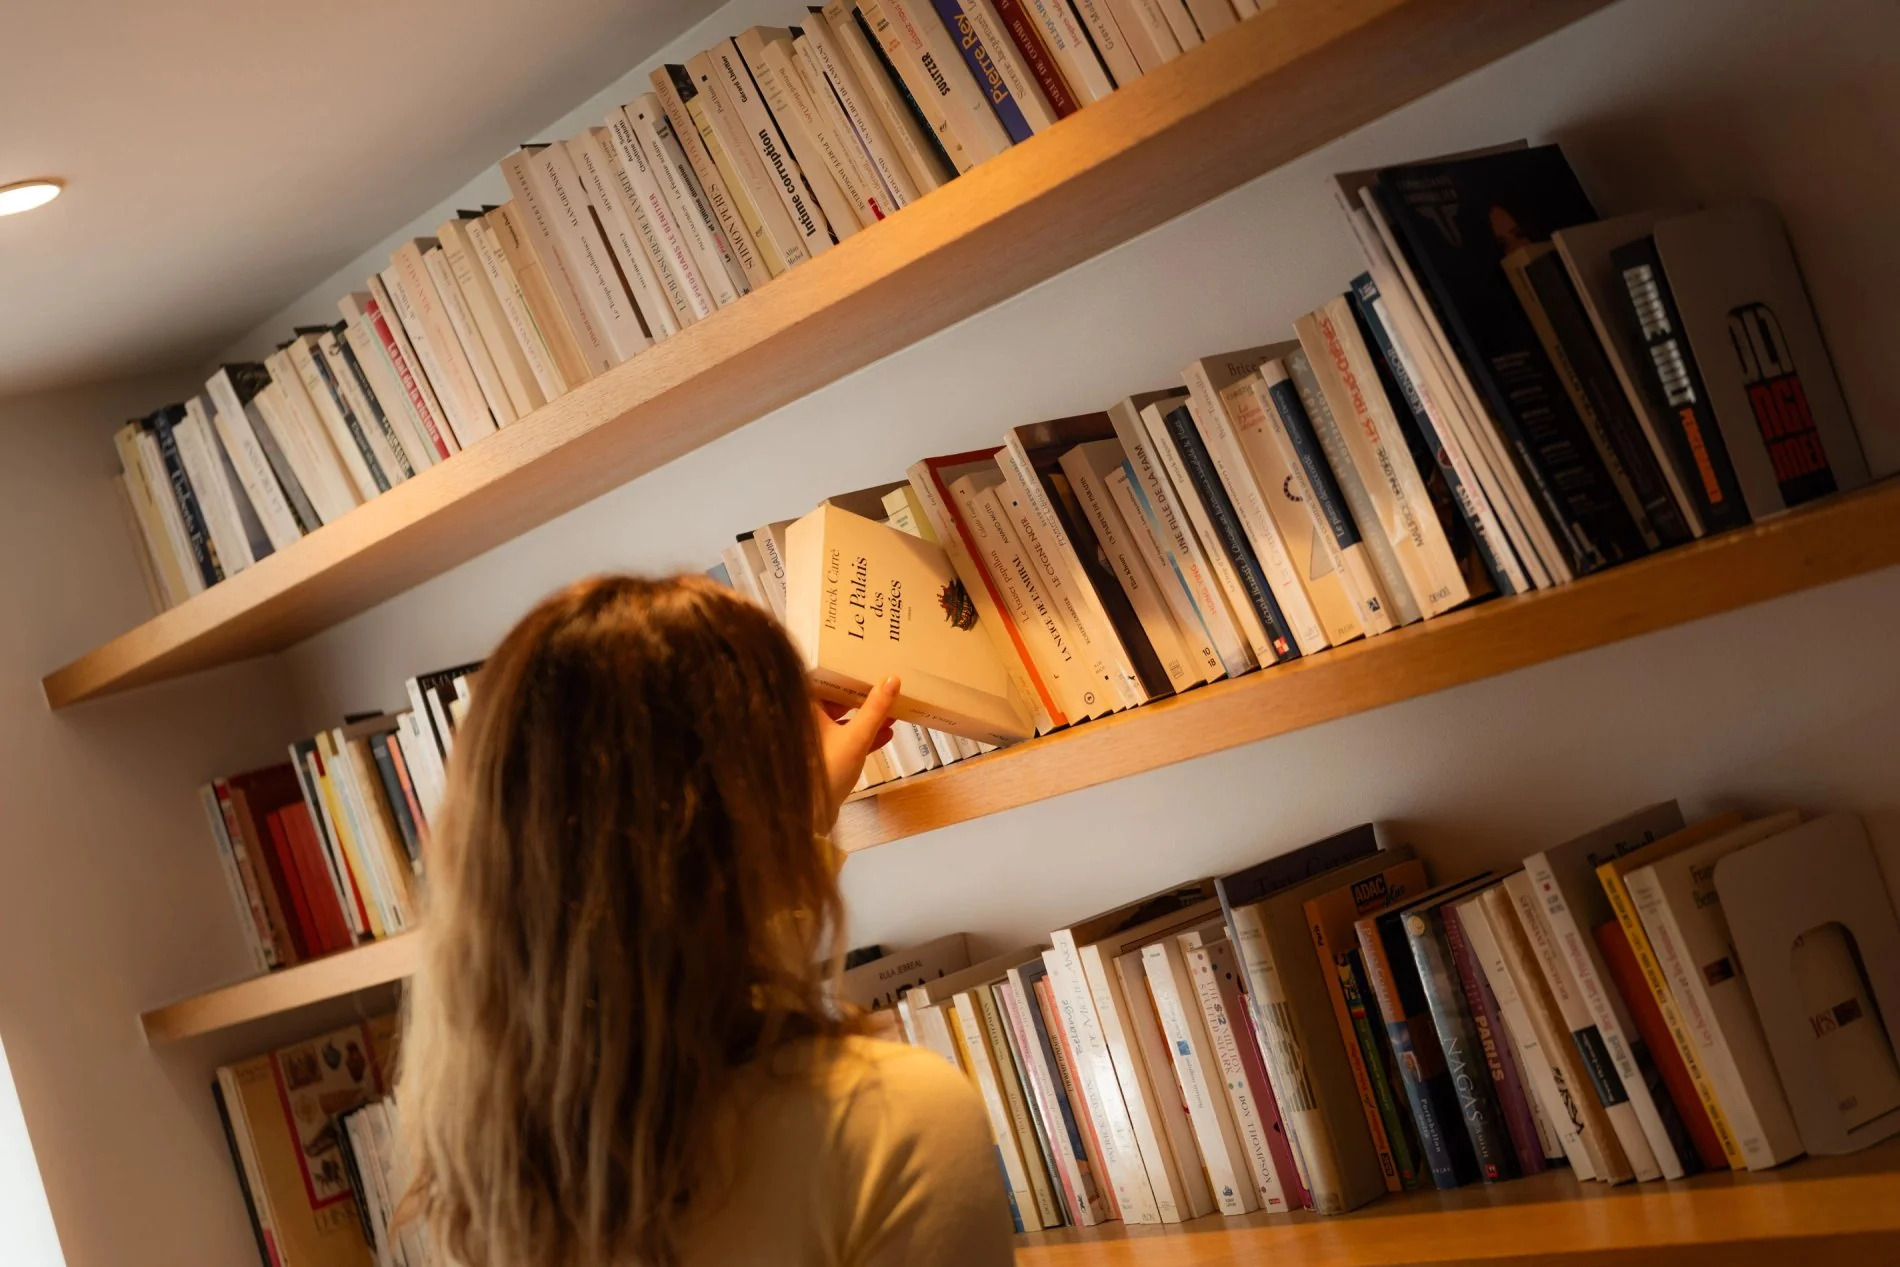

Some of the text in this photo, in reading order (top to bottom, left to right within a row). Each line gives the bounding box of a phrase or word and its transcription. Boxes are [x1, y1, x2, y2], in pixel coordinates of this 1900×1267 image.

[719, 54, 738, 81] Lhéritier
[814, 41, 843, 86] CAMPAGNE
[947, 10, 1011, 104] Pierre Rey
[1011, 18, 1047, 75] DE COLOMB
[732, 80, 749, 102] Gérard
[838, 84, 849, 97] DE
[919, 50, 952, 97] SULITZER
[844, 96, 868, 132] POULBOT
[610, 122, 634, 162] Anne Soupa
[616, 118, 648, 172] Christine Pedotti
[863, 130, 874, 144] UN
[580, 151, 614, 212] ANNE SINCLAIR
[649, 139, 682, 199] La Femme solaire
[676, 163, 698, 198] dimension
[753, 127, 799, 195] corruption
[816, 132, 825, 143] LA
[822, 140, 842, 169] PURETÉ
[837, 167, 866, 212] DANGEREUSE
[876, 155, 901, 194] ROULAND
[543, 161, 572, 206] GREENSPAN
[564, 206, 579, 226] ALAN
[707, 223, 716, 232] et
[787, 193, 818, 236] Intime
[632, 204, 687, 311] LES BLESSURES DE LA
[666, 232, 677, 245] LE
[671, 244, 690, 271] DANS
[722, 253, 731, 262] Le
[725, 220, 757, 270] SHIMON
[683, 270, 703, 297] PIEDS
[696, 297, 710, 315] LES
[401, 373, 415, 389] de
[1386, 344, 1424, 414] KRONDOR
[1648, 338, 1697, 407] HOLT
[1362, 417, 1381, 444] LES
[1078, 475, 1095, 502] PARADIS
[1091, 501, 1100, 511] DE
[1132, 443, 1191, 554] UNE FILLE DE LA FAIM
[1300, 452, 1345, 537] Le piano désaccordé
[983, 502, 1009, 544] ALVARO MUTIS
[1031, 487, 1067, 547] FEMMES LIBRES
[1095, 510, 1112, 535] PARFUM
[1138, 514, 1147, 525] Les
[1240, 490, 1293, 587] La Confession
[1290, 461, 1345, 573] Des gens comme les autres
[1397, 499, 1425, 547] MAURICE
[762, 538, 785, 579] CHAUVIN
[1108, 534, 1116, 544] UN
[987, 547, 1030, 622] Le baiser papillon
[1019, 515, 1091, 644] ROBERT SABATIER LE CYGNE NOIR
[1115, 552, 1133, 575] Khoury
[825, 548, 838, 629] Patrick Carré
[849, 555, 867, 639] Le Palais
[869, 591, 885, 617] des
[887, 578, 902, 641] nuages
[1009, 552, 1073, 661] LA NEIGE DE L'AMIRAL
[1187, 563, 1219, 614] HONG YING
[1253, 595, 1275, 625] Gérard
[1201, 645, 1213, 658] 10
[1206, 656, 1217, 668] 18
[1352, 876, 1386, 903] ADAC
[1312, 924, 1325, 946] Paris
[1197, 983, 1233, 1075] STUFFED SHARK
[1205, 981, 1242, 1074] THE $12 MILLION
[1474, 1014, 1505, 1082] PARIJS
[1058, 1061, 1074, 1092] L'HOMME
[1442, 1033, 1489, 1159] NAGAS AMISH
[1097, 1119, 1117, 1163] PATRICK
[1237, 1094, 1272, 1184] DON THOMPSON
[1418, 1097, 1443, 1153] Portobellon
[1380, 1152, 1393, 1176] ADAC
